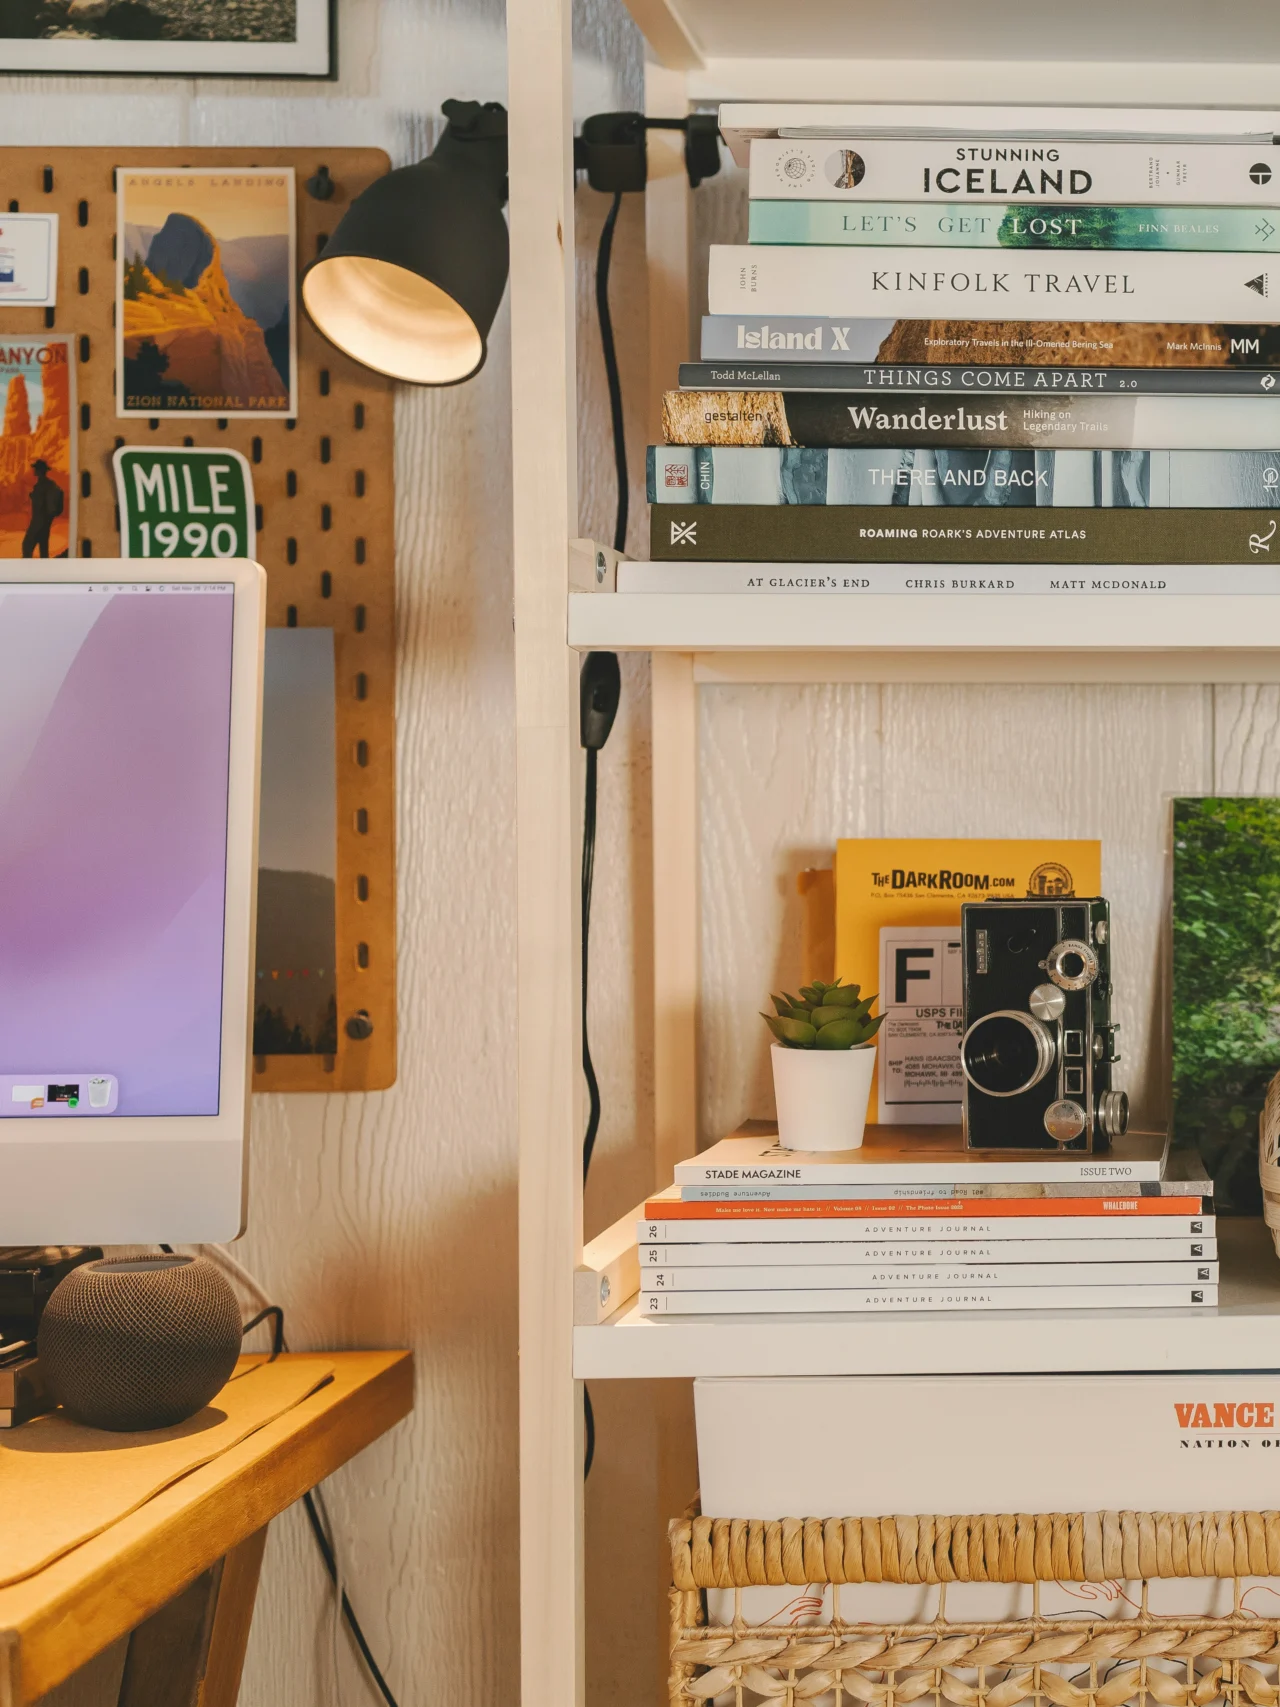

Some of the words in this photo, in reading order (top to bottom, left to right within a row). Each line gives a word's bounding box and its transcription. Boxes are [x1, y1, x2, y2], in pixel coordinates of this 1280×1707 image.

[956, 147, 1060, 162] STUNNING
[129, 179, 195, 187] ANGELS
[210, 179, 285, 188] LANDING
[924, 167, 1093, 195] ICELAND
[842, 215, 917, 233] LET'S
[938, 216, 991, 233] GET
[1011, 218, 1082, 235] LOST
[1139, 224, 1168, 233] FINN
[1174, 225, 1219, 233] BEALES
[872, 271, 1010, 292] KINFOLK
[1025, 274, 1135, 294] TRAVEL
[737, 324, 823, 350] Island
[831, 327, 850, 350] X
[925, 338, 970, 348] Exploratory
[972, 339, 999, 347] Travels
[1011, 340, 1024, 348] the
[1026, 340, 1069, 348] Ill-Omened
[1073, 341, 1097, 350] Bering
[1099, 341, 1113, 349] Sea
[1167, 342, 1188, 350] Mark
[1190, 342, 1221, 351] McInnis
[1231, 339, 1259, 354] MM
[711, 370, 735, 380] Todd
[737, 371, 780, 381] McLellan
[864, 369, 952, 386] THINGS
[961, 371, 1025, 387] COME
[1034, 373, 1107, 387] APART
[1120, 380, 1137, 388] 2.0
[127, 396, 161, 406] ZION
[167, 397, 242, 408] NATIONAL
[248, 397, 286, 408] PARK
[705, 411, 763, 423] gestalten
[848, 406, 1009, 431] Wanderlust
[1023, 410, 1056, 420] Hiking
[1059, 411, 1071, 419] on
[1023, 422, 1077, 432] Legendary
[1080, 422, 1108, 431] Trails
[700, 461, 710, 490] CHIN
[868, 469, 936, 485] THERE
[944, 470, 986, 486] AND
[995, 470, 1049, 486] BACK
[132, 463, 235, 514] MILE
[138, 522, 238, 558] 1990
[860, 529, 917, 538] ROAMING
[922, 529, 972, 538] ROARK'S
[976, 530, 1045, 539] ADVENTURE
[1050, 530, 1086, 539] ATLAS
[747, 578, 763, 587] AT
[769, 577, 837, 588] GLACIER'S
[844, 578, 870, 588] END
[906, 579, 945, 588] CHRIS
[952, 580, 1015, 588] BURKARD
[1050, 580, 1085, 588] MATT
[1092, 580, 1166, 589] MCDONALD
[895, 948, 934, 1003] F
[916, 1008, 946, 1018] USPS
[705, 1170, 739, 1179] STADE
[742, 1169, 801, 1179] MAGAZINE
[1080, 1168, 1107, 1176] ISSUE
[1109, 1167, 1132, 1176] TWO
[894, 1188, 934, 1196] friendship
[1103, 1201, 1138, 1210] WHALEBONE
[649, 1225, 658, 1238] 26
[649, 1250, 658, 1262] 25
[656, 1274, 665, 1286] 24
[650, 1298, 658, 1310] 23
[1174, 1402, 1274, 1428] VANCE
[1180, 1439, 1251, 1448] NATION
